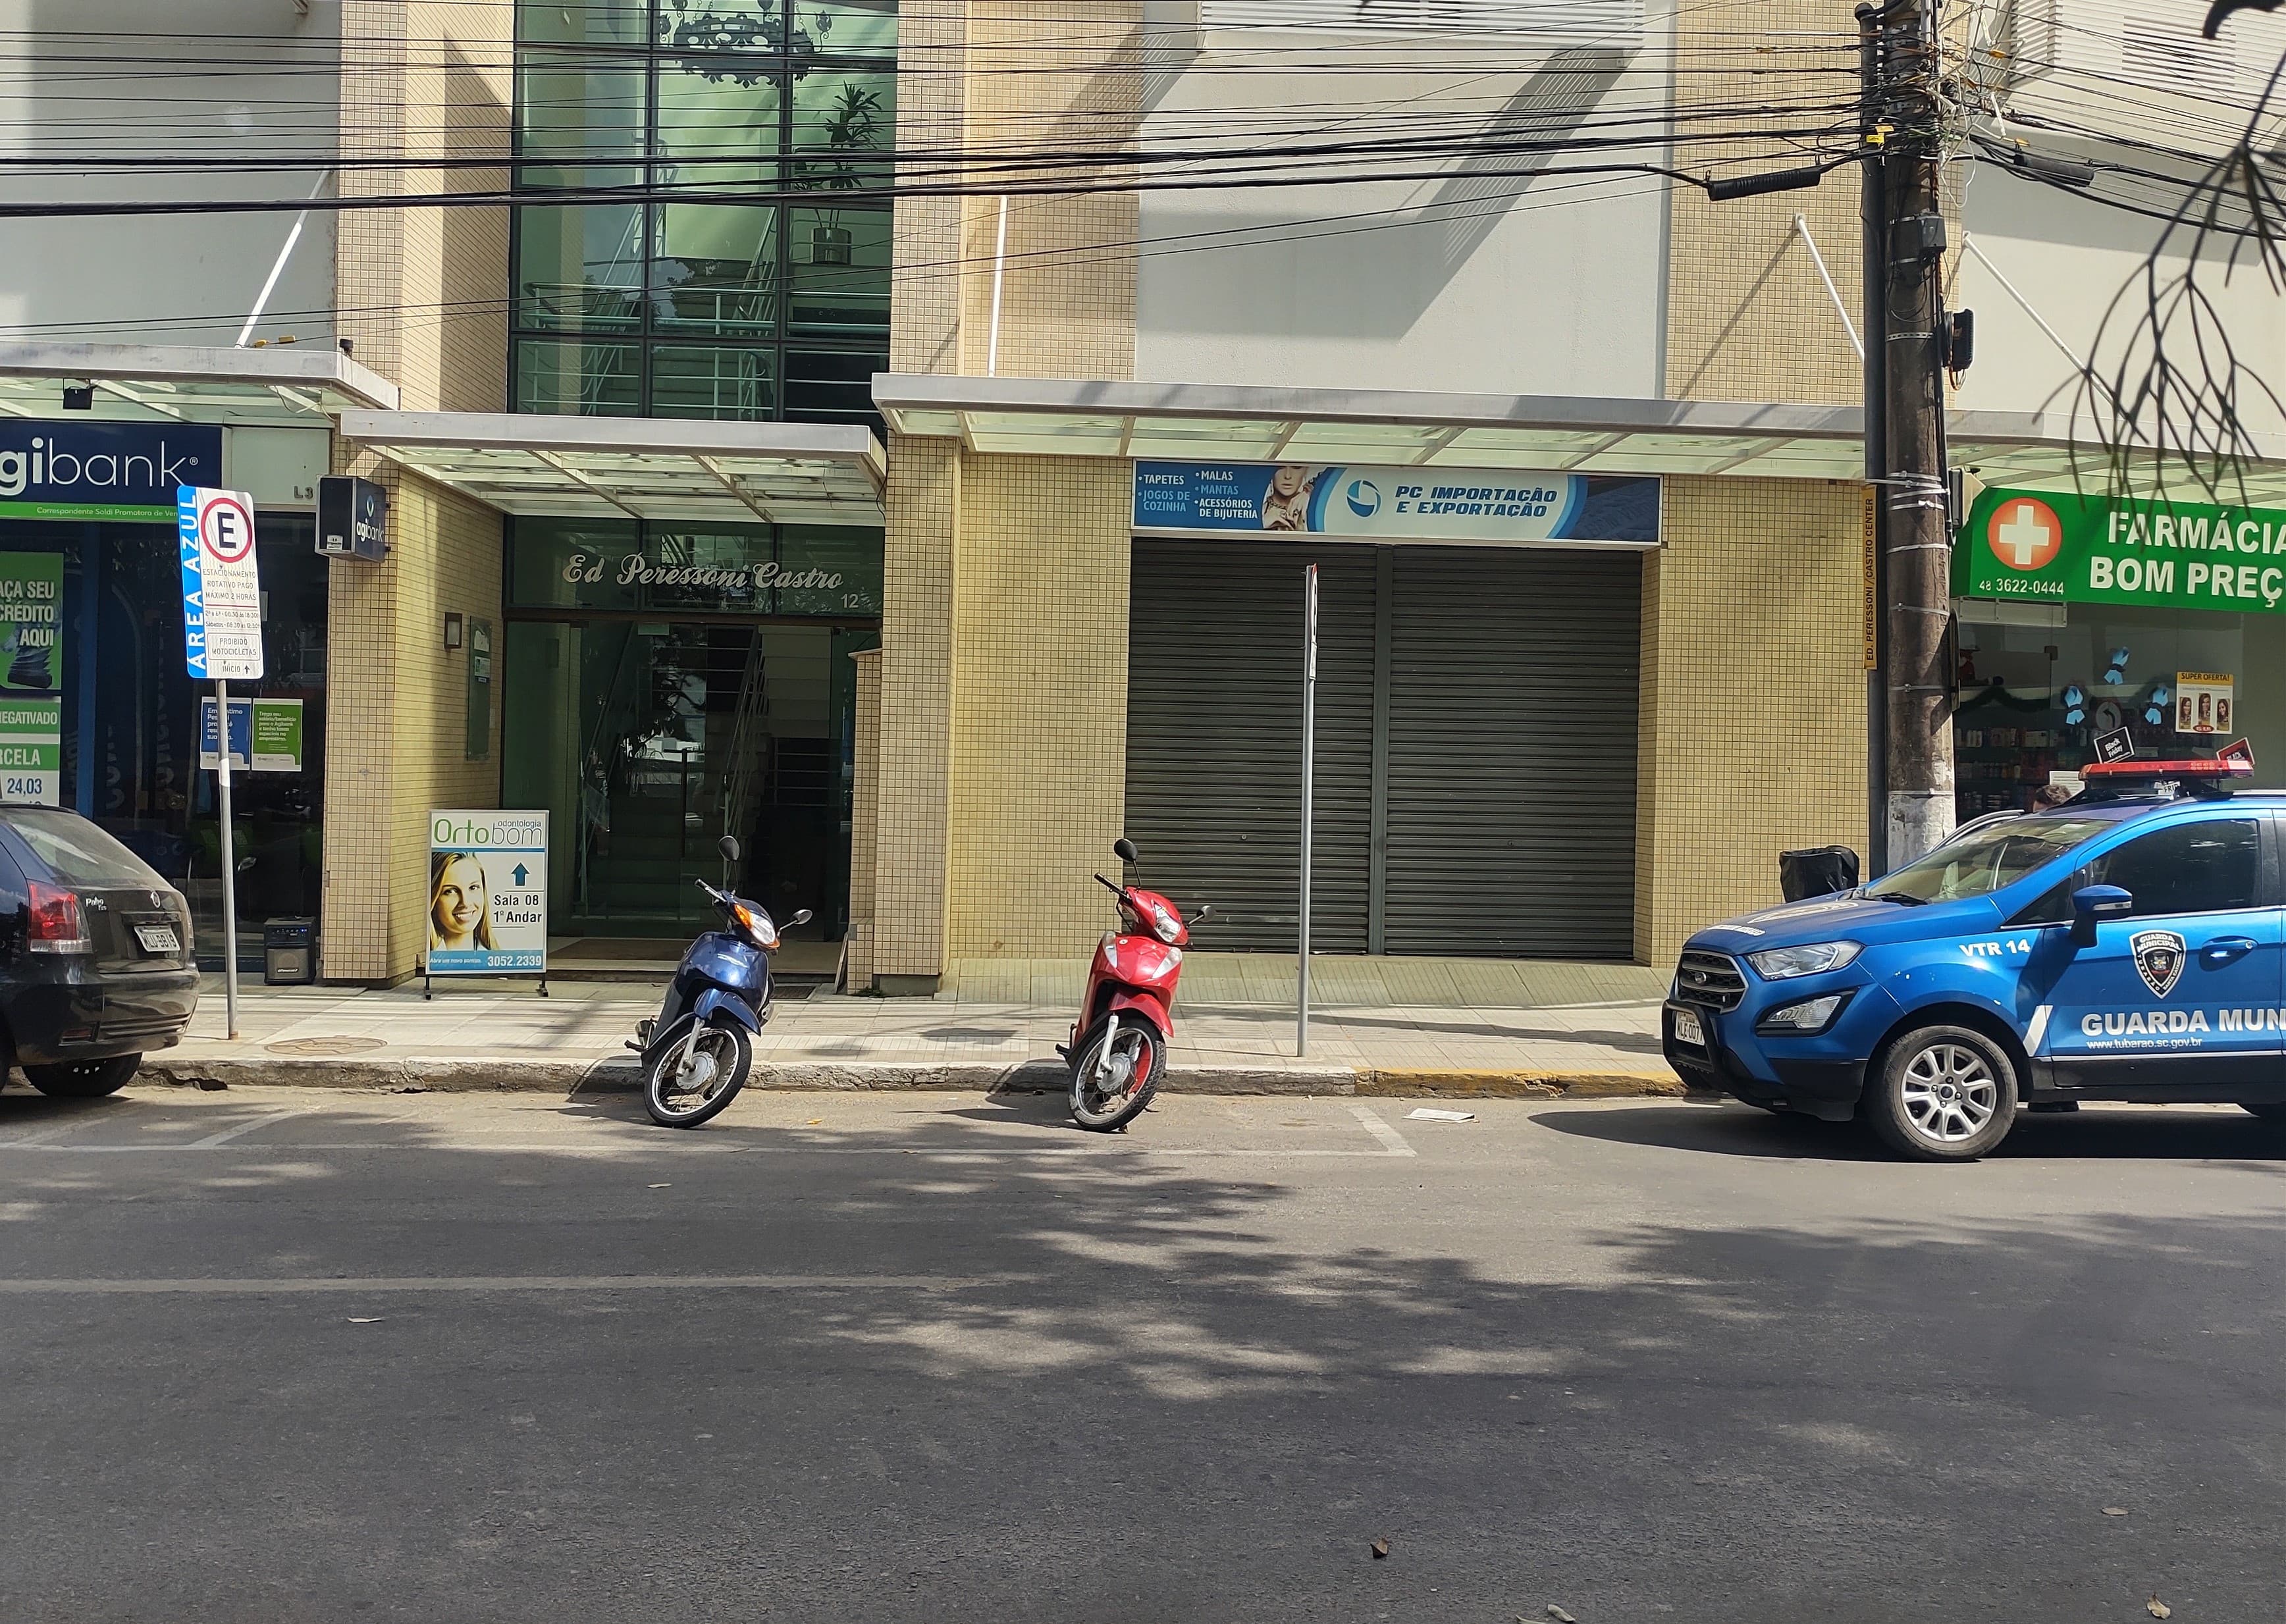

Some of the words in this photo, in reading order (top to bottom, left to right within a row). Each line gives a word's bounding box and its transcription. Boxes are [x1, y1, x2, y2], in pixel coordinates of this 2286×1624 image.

[1144, 474, 1184, 485] TAPETES
[1201, 470, 1233, 481] MALAS
[294, 486, 313, 500] L3
[1143, 490, 1174, 502] JOGOS
[1178, 492, 1190, 502] DE
[1201, 485, 1238, 496] MANTAS
[1395, 485, 1423, 499] PC
[1430, 486, 1558, 504] IMPORTAÇÃO
[1143, 501, 1186, 512] COZINHA
[1199, 496, 1252, 509] ACESSÓRIOS
[1396, 500, 1410, 513] E
[1416, 501, 1547, 518] EXPORTAÇÃO
[37, 507, 94, 516] Correspondente
[1199, 508, 1212, 518] DE
[1213, 508, 1258, 520] BIJUTERIA
[1865, 498, 1874, 537] CENTER
[180, 495, 200, 573] AZUL
[217, 511, 237, 549] E
[356, 518, 385, 542] agibank
[2108, 511, 2286, 555] FARMÁCIA
[203, 568, 256, 578] ESTACIONAMENTO
[562, 554, 604, 584] Ed
[616, 552, 748, 588] Peressoni
[753, 562, 844, 589] Castro
[207, 580, 236, 589] ROTATIVO
[1979, 580, 1992, 591] 48
[1996, 579, 2065, 595] 3622-0444
[2090, 556, 2174, 593] BOM
[2187, 562, 2286, 608] PREÇ
[27, 581, 55, 598] SEU
[205, 590, 229, 600] MÁXIMO
[1865, 587, 1874, 642] PERESSONI
[19, 629, 53, 646] AQUI
[219, 637, 248, 646] PROIBIDO
[7, 777, 43, 797] 24,03
[498, 819, 542, 829] odontologia
[434, 818, 543, 845] Ortobom
[494, 894, 519, 906] Sala
[525, 894, 539, 906] 08
[494, 910, 504, 923] 1º
[506, 910, 543, 923] Andar
[2139, 933, 2175, 943] GUARDA
[1959, 942, 2003, 957] VTR
[2006, 939, 2031, 955] 14
[2137, 940, 2182, 953] MUNICIPAL
[487, 955, 542, 967] 3052.2339
[2081, 1009, 2211, 1036] GUARDA
[2218, 1008, 2286, 1032] MUN
[2086, 1037, 2202, 1050] www.tubarao.sc.gov.br
